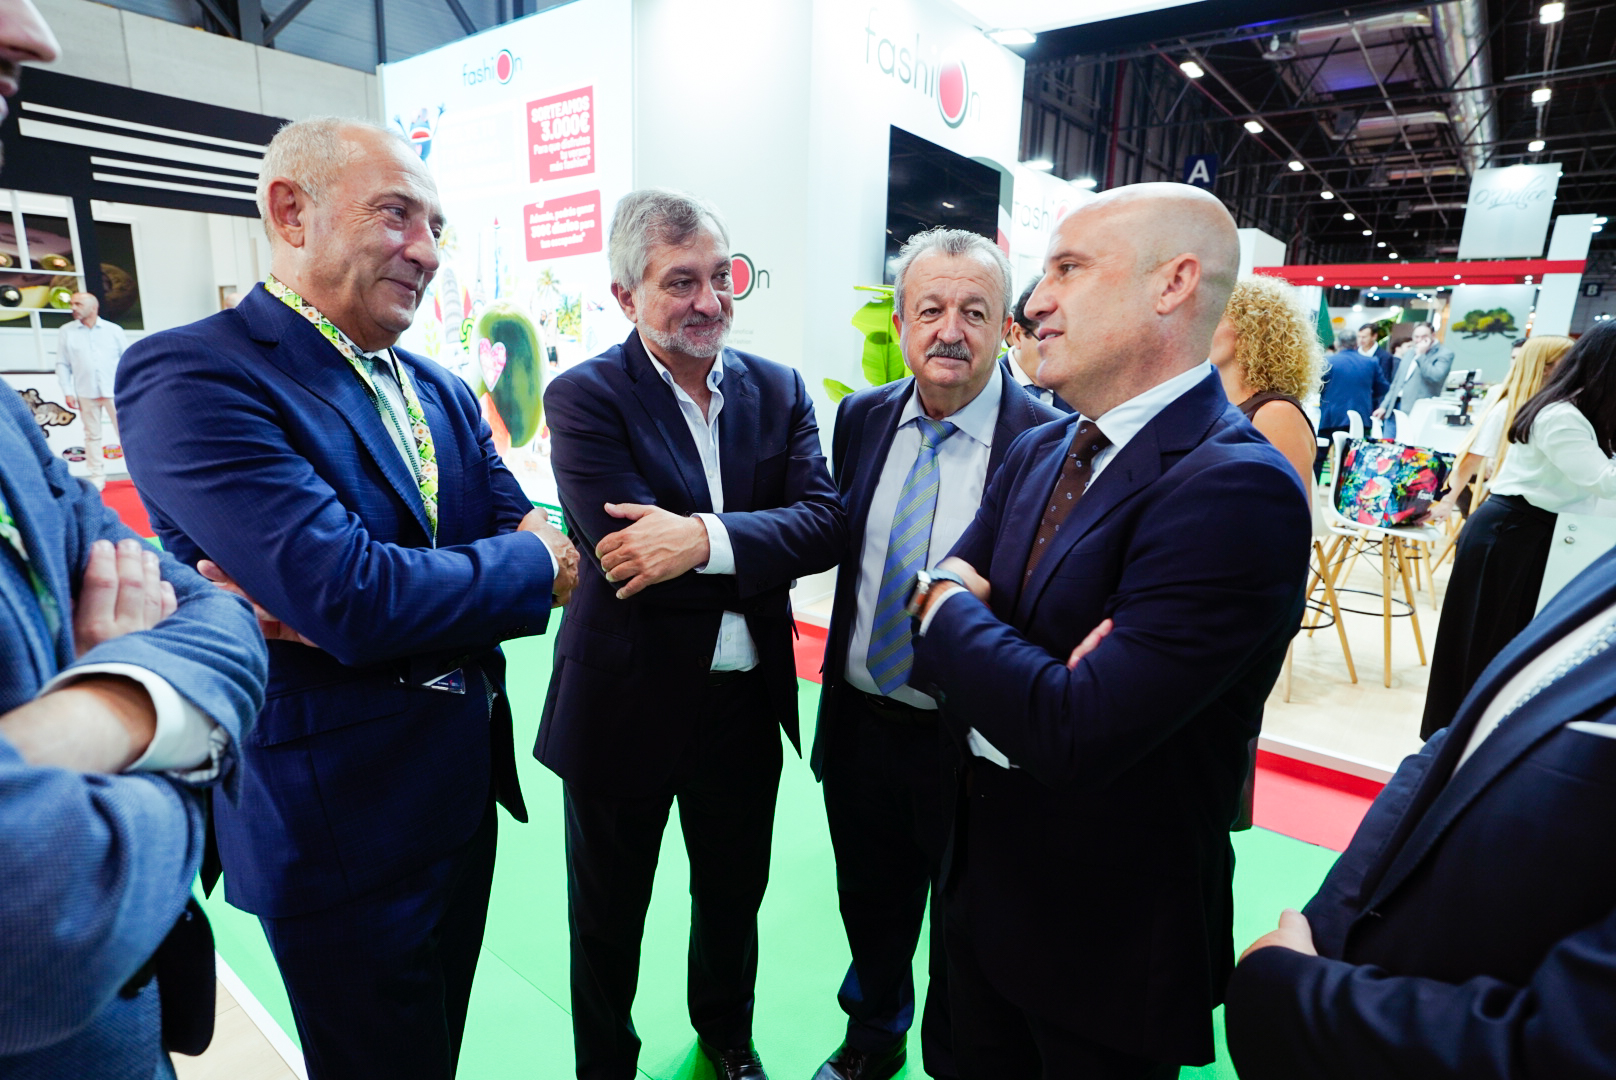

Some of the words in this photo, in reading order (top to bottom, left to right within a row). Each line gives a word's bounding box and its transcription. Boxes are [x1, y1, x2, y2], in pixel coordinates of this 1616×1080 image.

[531, 95, 590, 123] SORTEAMOS
[541, 111, 590, 141] 3.000€
[1187, 159, 1210, 184] A
